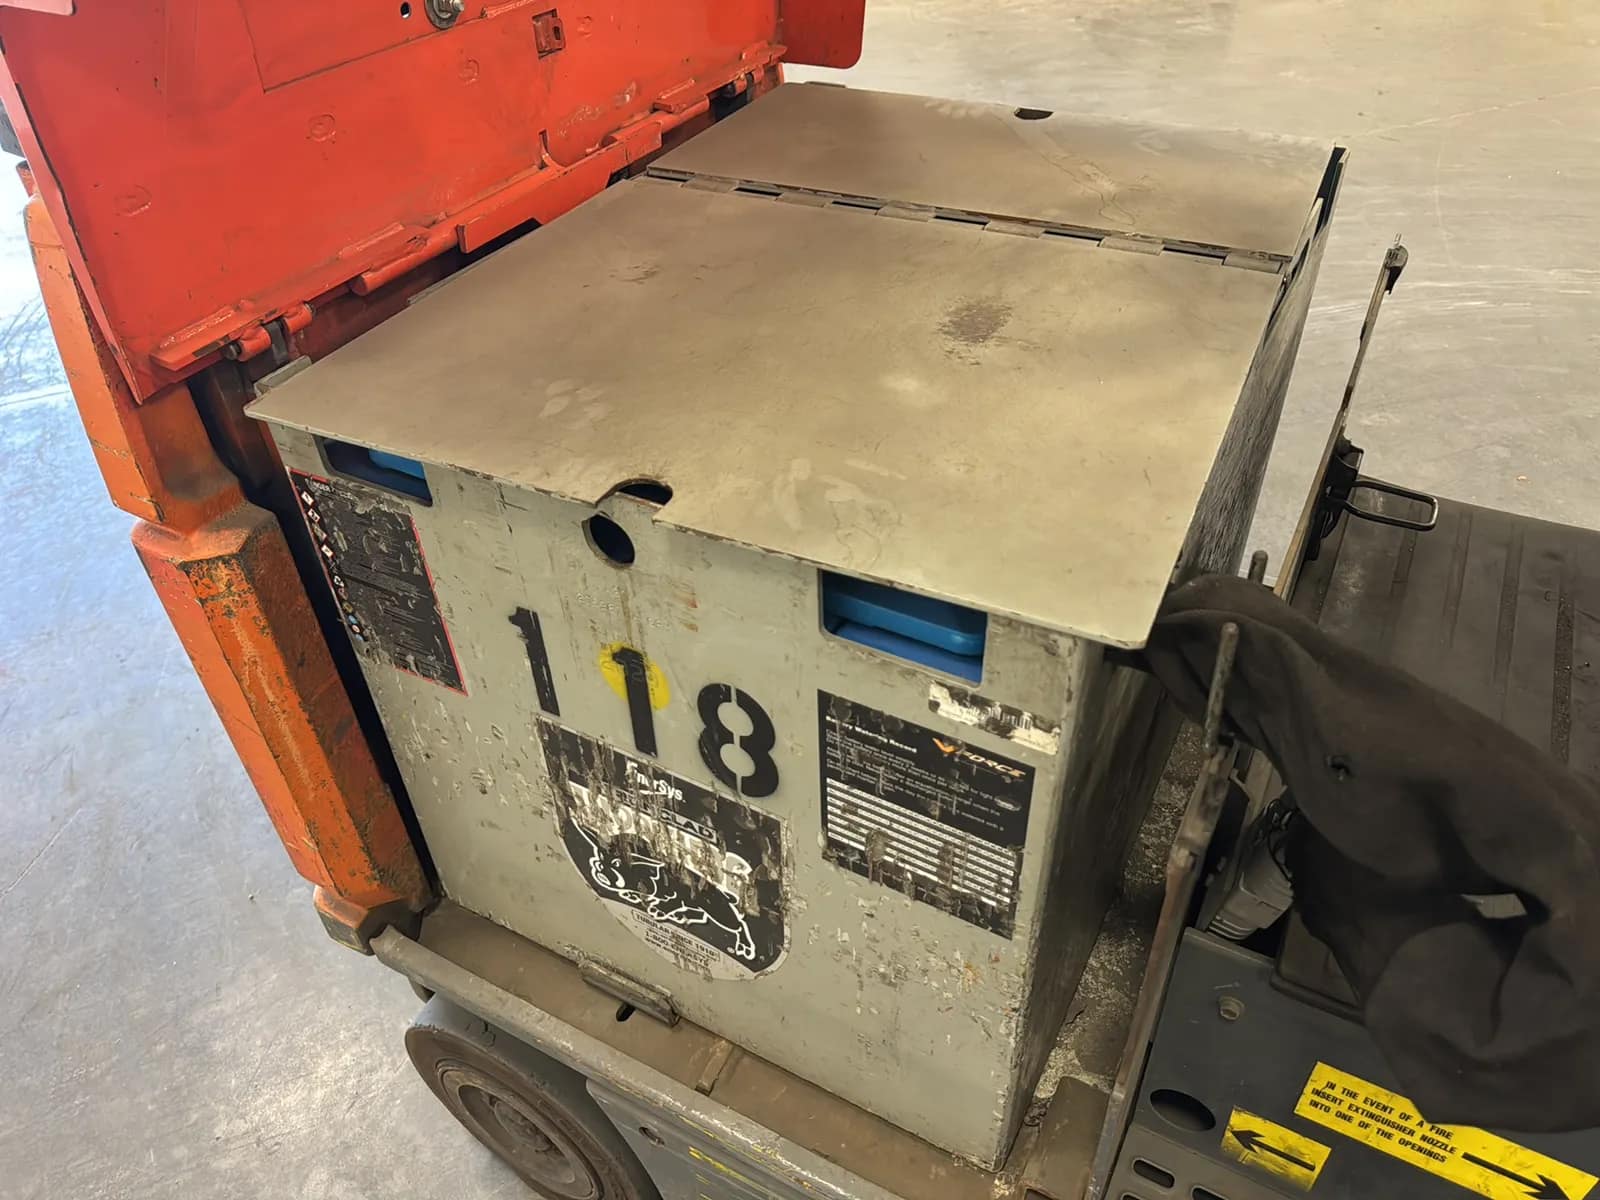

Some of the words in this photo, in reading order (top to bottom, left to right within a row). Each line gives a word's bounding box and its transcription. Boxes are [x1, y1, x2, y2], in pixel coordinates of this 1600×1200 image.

[889, 739, 917, 753] Record
[1309, 1099, 1332, 1114] INTO
[1335, 1110, 1355, 1124] ONE
[1358, 1120, 1372, 1130] OF
[1376, 1127, 1395, 1141] THE
[1398, 1136, 1449, 1164] OPENINGS
[1311, 1087, 1345, 1107] INSERT
[1348, 1103, 1416, 1138] EXTINGUISHER
[1419, 1133, 1458, 1154] NOZZLE
[1326, 1081, 1336, 1091] IN
[1342, 1086, 1359, 1101] THE
[1363, 1096, 1395, 1116] EVENT
[1399, 1111, 1414, 1123] OF
[1416, 1119, 1425, 1129] A
[1429, 1124, 1455, 1141] FIRE
